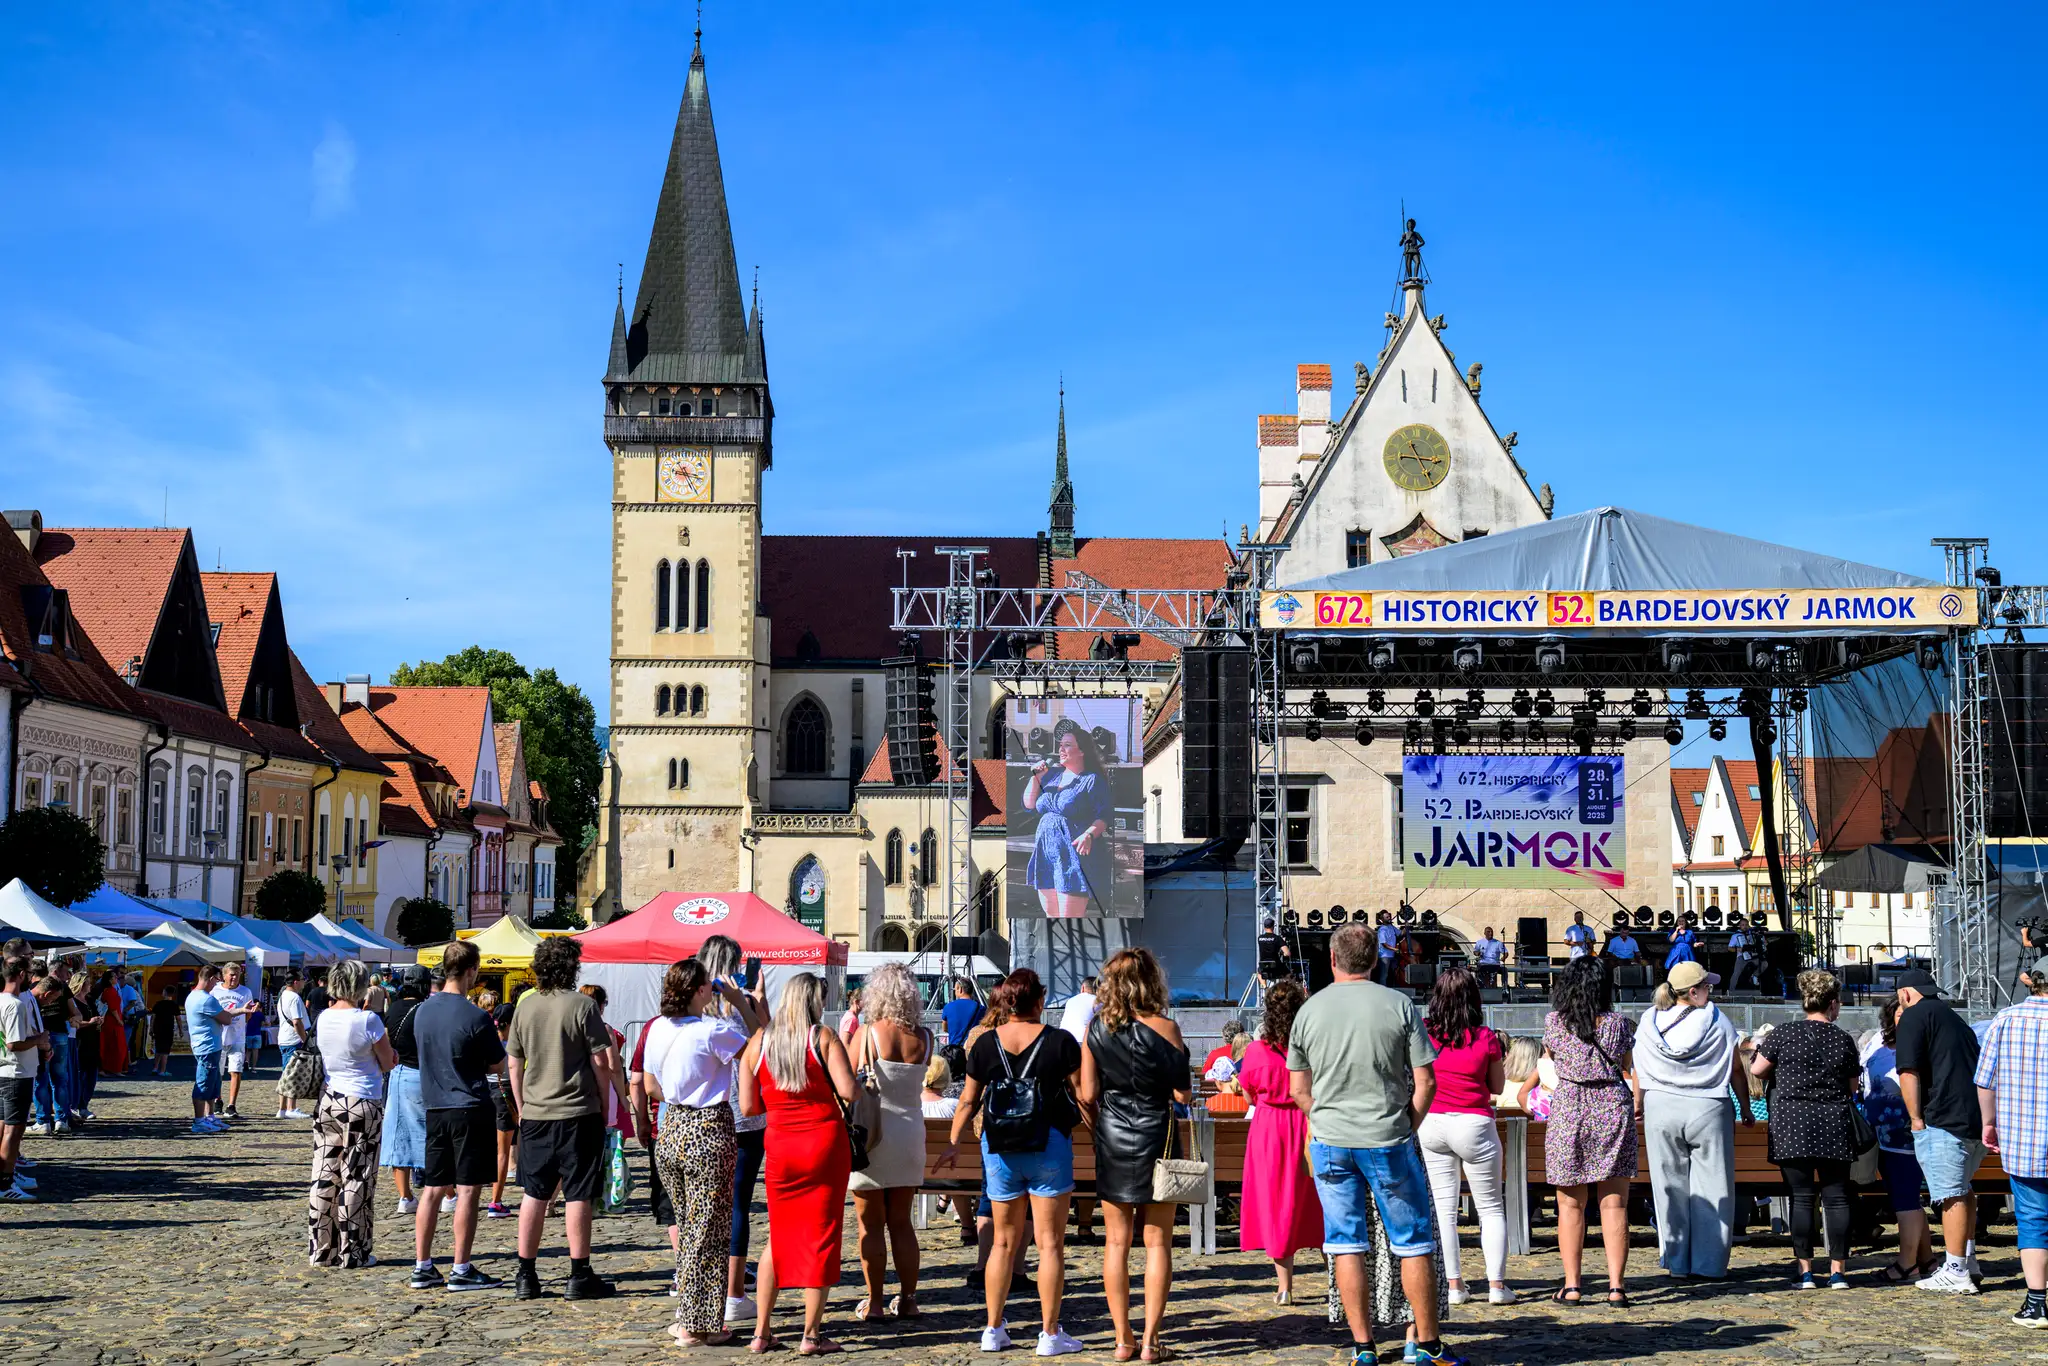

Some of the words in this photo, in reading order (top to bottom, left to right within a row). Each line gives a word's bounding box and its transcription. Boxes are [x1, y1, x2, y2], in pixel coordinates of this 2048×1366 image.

[1318, 596, 1371, 624] 672.
[1383, 595, 1539, 622] HISTORICKÝ
[1553, 595, 1592, 624] 52.
[1600, 593, 1790, 622] BARDEJOVSKÝ
[1802, 596, 1916, 620] JARMOK
[1458, 771, 1492, 786] 672.
[1494, 772, 1567, 786] HISTORICKÝ
[1588, 769, 1609, 782] 28.
[1588, 788, 1609, 801] 31.
[1424, 798, 1463, 820] 52.
[1413, 826, 1613, 868] JARMOK
[741, 947, 821, 958] www.redcross.sk
